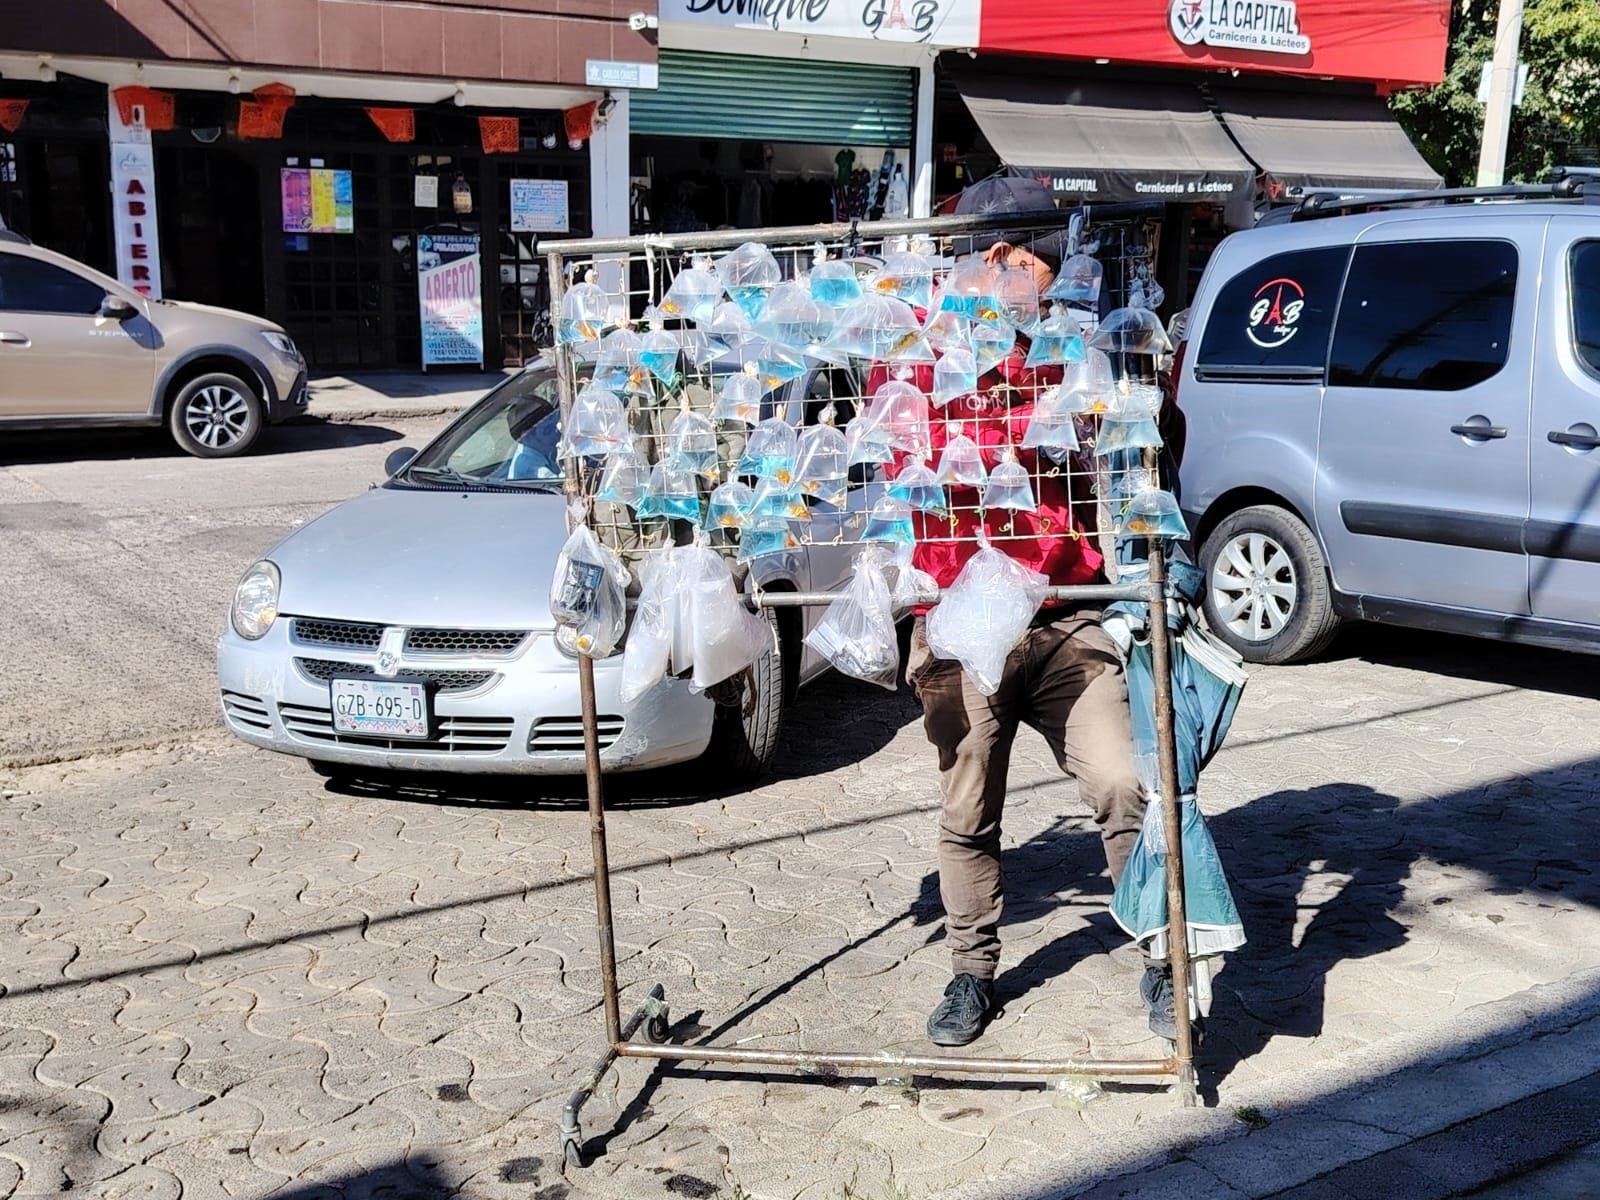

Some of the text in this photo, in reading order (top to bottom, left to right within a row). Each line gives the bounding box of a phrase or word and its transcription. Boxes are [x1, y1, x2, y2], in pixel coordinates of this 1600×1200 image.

[1210, 0, 1294, 34] LA CAPITAL
[1260, 35, 1267, 45] &
[1053, 178, 1065, 191] LA
[1065, 178, 1098, 192] CAPITAL
[1187, 182, 1195, 193] &
[425, 260, 476, 316] ABIERTO
[336, 694, 423, 720] GZB-695-D
